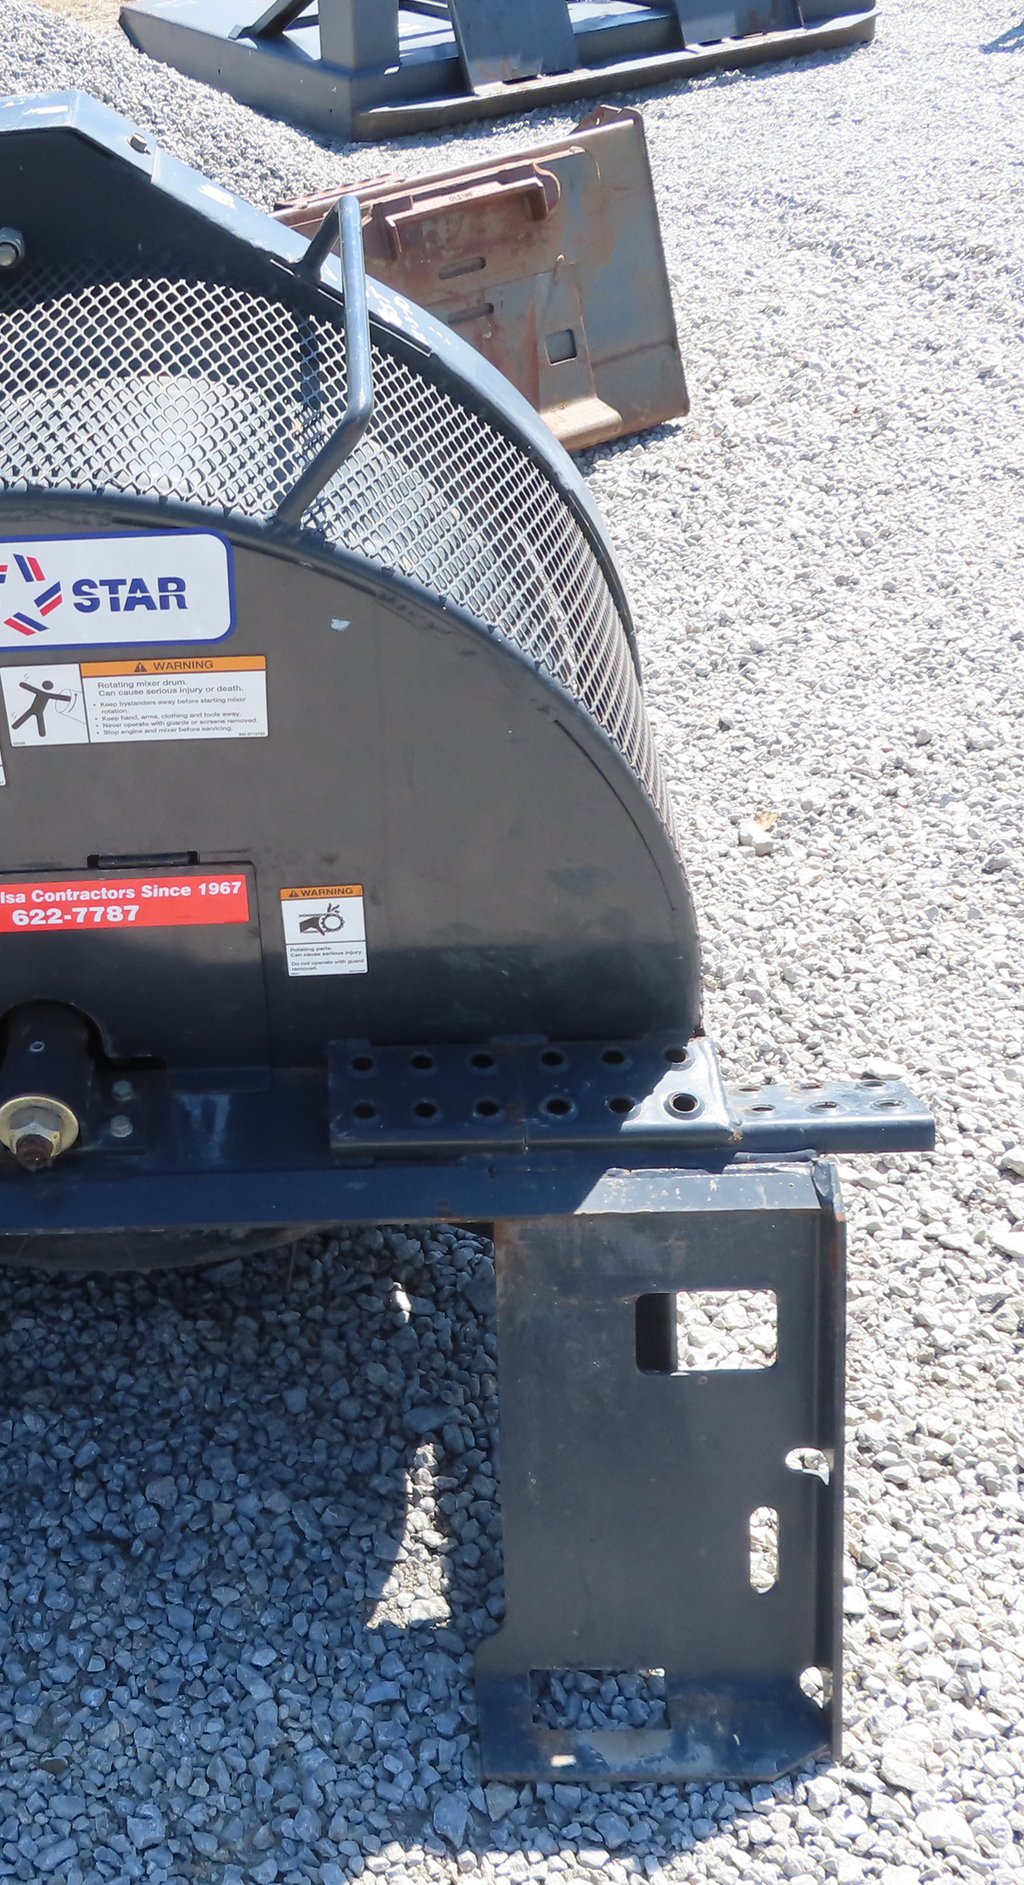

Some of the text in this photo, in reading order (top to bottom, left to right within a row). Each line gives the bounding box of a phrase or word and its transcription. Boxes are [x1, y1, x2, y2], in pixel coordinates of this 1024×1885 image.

[72, 576, 189, 613] STAR
[153, 660, 214, 670] WARNING
[97, 681, 134, 689] Rotating
[161, 712, 188, 720] clothing
[31, 886, 136, 904] Contractors
[141, 884, 191, 898] Since
[198, 881, 242, 896] 1967
[300, 887, 353, 897] WARNING
[11, 904, 140, 926] 622-7787
